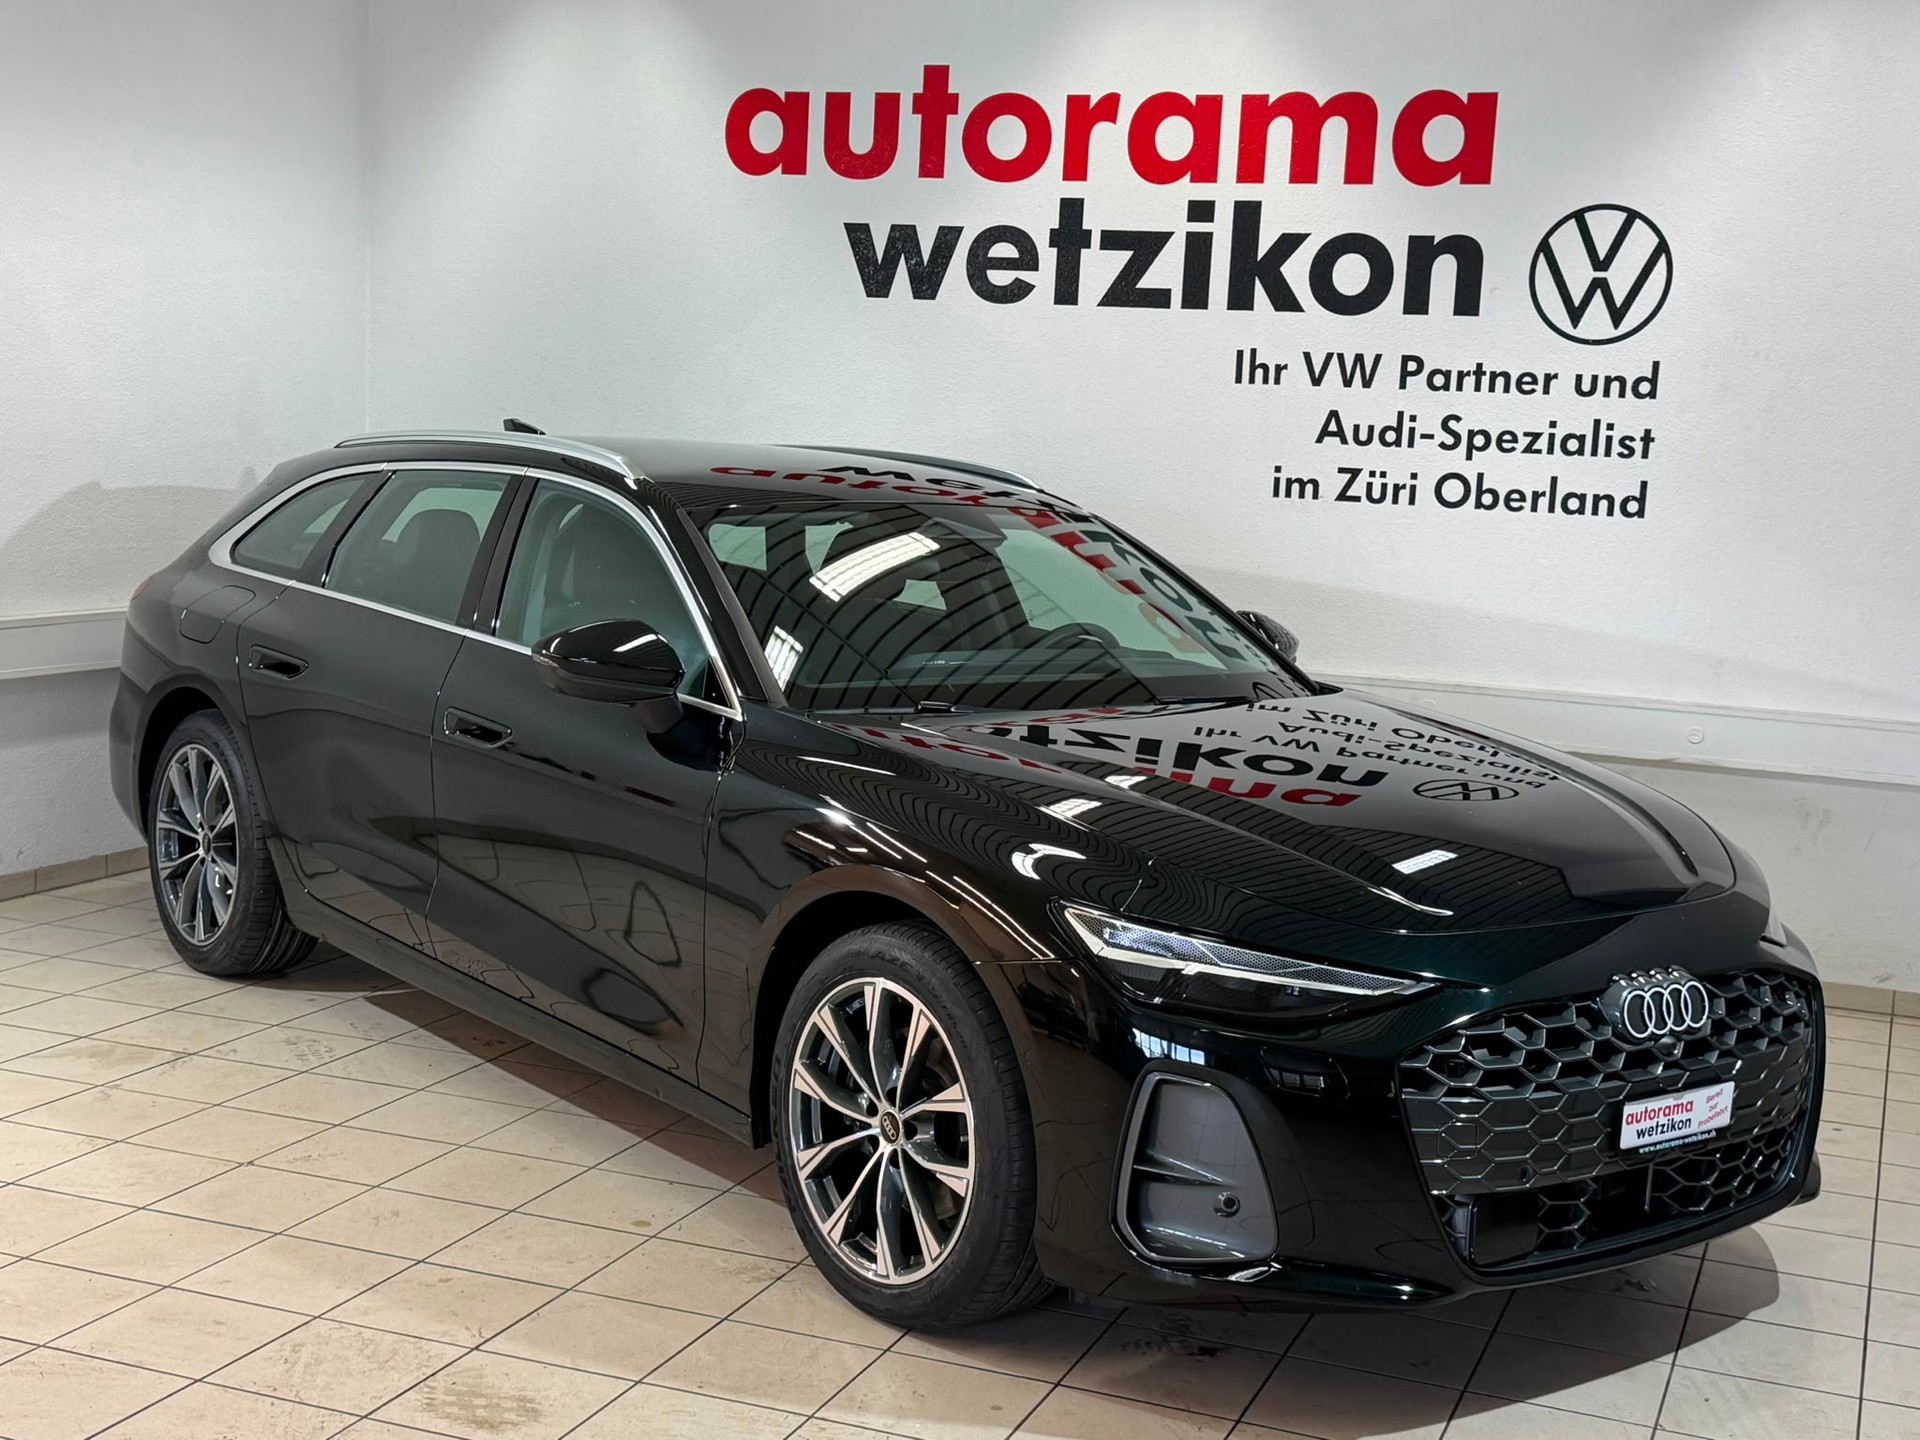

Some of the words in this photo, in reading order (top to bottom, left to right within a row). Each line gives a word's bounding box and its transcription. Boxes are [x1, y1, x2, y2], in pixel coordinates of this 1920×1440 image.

[725, 65, 1499, 188] autorama
[843, 197, 1484, 317] wetzikon
[1234, 347, 1289, 386] Ihr
[1302, 351, 1383, 389] VW
[1398, 354, 1559, 396] Partner
[1574, 360, 1660, 400] und
[1314, 409, 1656, 461] Audi-Spezialist
[1272, 465, 1320, 500] im
[1334, 466, 1418, 506] Züri
[1434, 472, 1648, 519] Oberland
[1625, 1100, 1694, 1126] autorama
[1635, 1117, 1692, 1140] wetzikon
